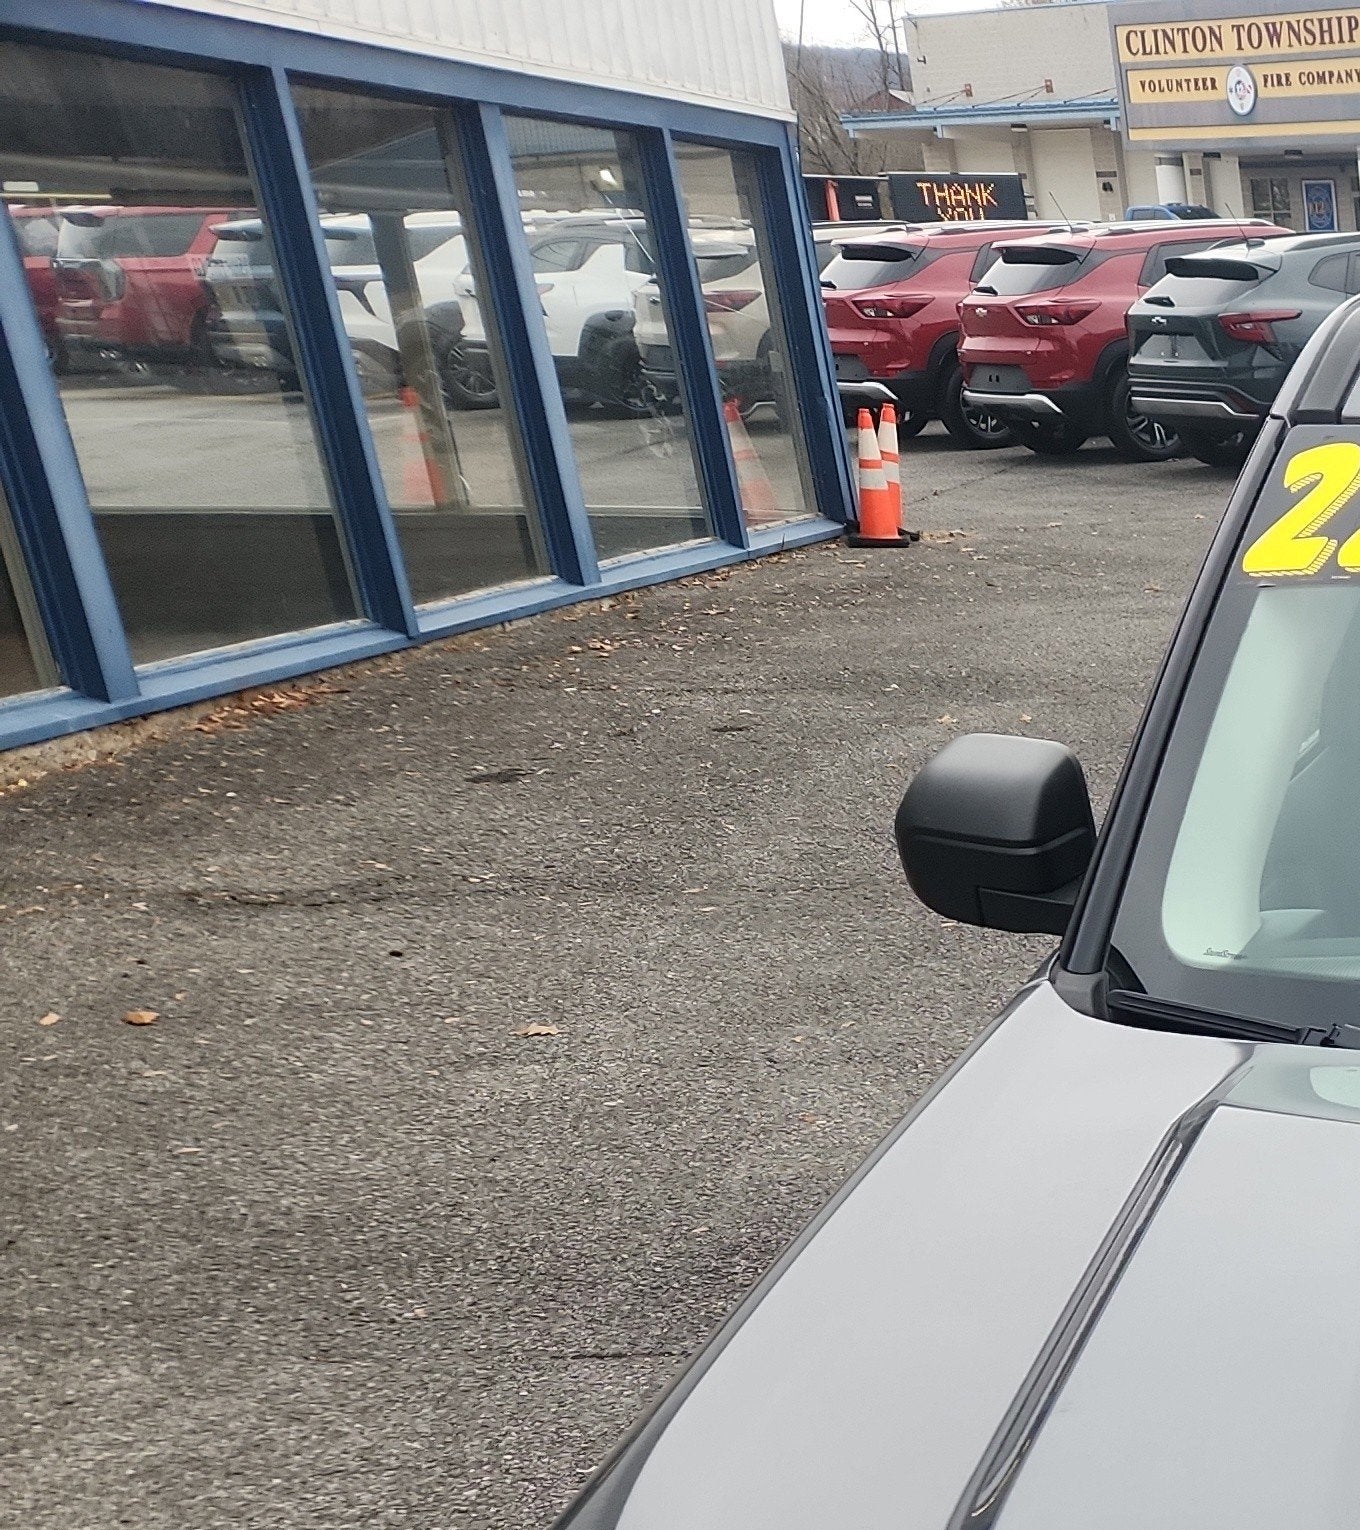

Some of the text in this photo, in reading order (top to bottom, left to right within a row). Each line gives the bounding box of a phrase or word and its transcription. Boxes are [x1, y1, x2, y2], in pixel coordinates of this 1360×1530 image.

[1125, 15, 1360, 56] CLINTON TOWNSHIP
[1139, 76, 1218, 93] VOLUNTEER
[1262, 72, 1292, 88] FIRE
[916, 182, 998, 207] THANK
